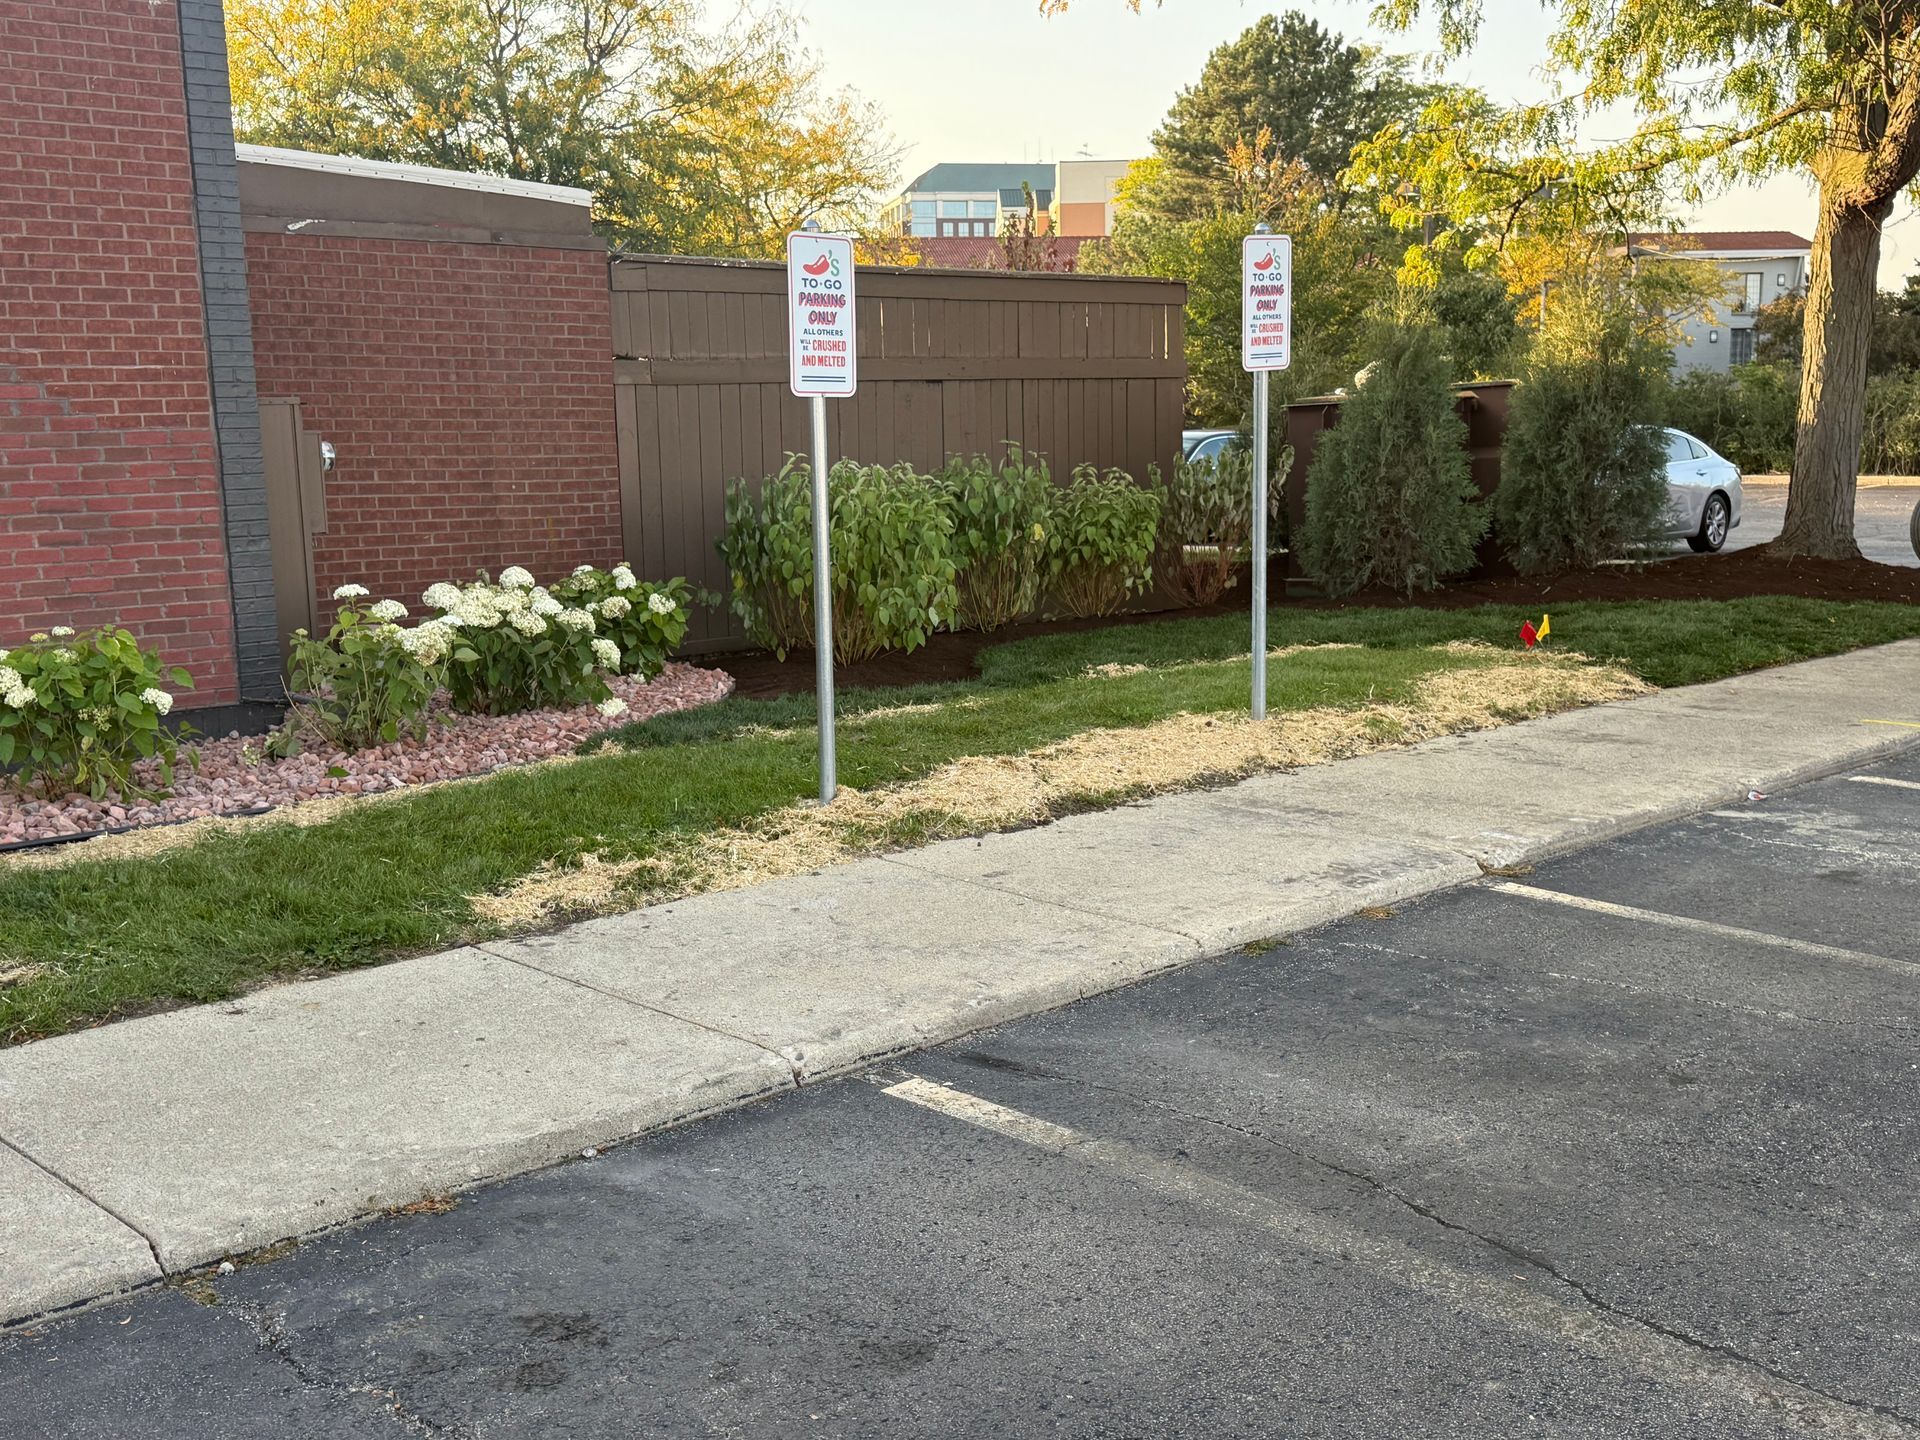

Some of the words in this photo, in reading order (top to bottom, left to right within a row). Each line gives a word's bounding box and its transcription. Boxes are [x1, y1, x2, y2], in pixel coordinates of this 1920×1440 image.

[1250, 284, 1284, 297] PARKING
[798, 291, 846, 308] PARKING
[1256, 299, 1278, 312] ONLY
[808, 310, 838, 326] ONLY
[803, 328, 816, 336] ALL
[817, 328, 844, 336] OTHERS
[1258, 322, 1284, 333] CRUSHED
[812, 339, 847, 352] CRUSHED
[1251, 336, 1261, 346] AND
[1262, 335, 1283, 346] MELTED
[801, 354, 817, 366] AND
[817, 355, 846, 368] MELTED
